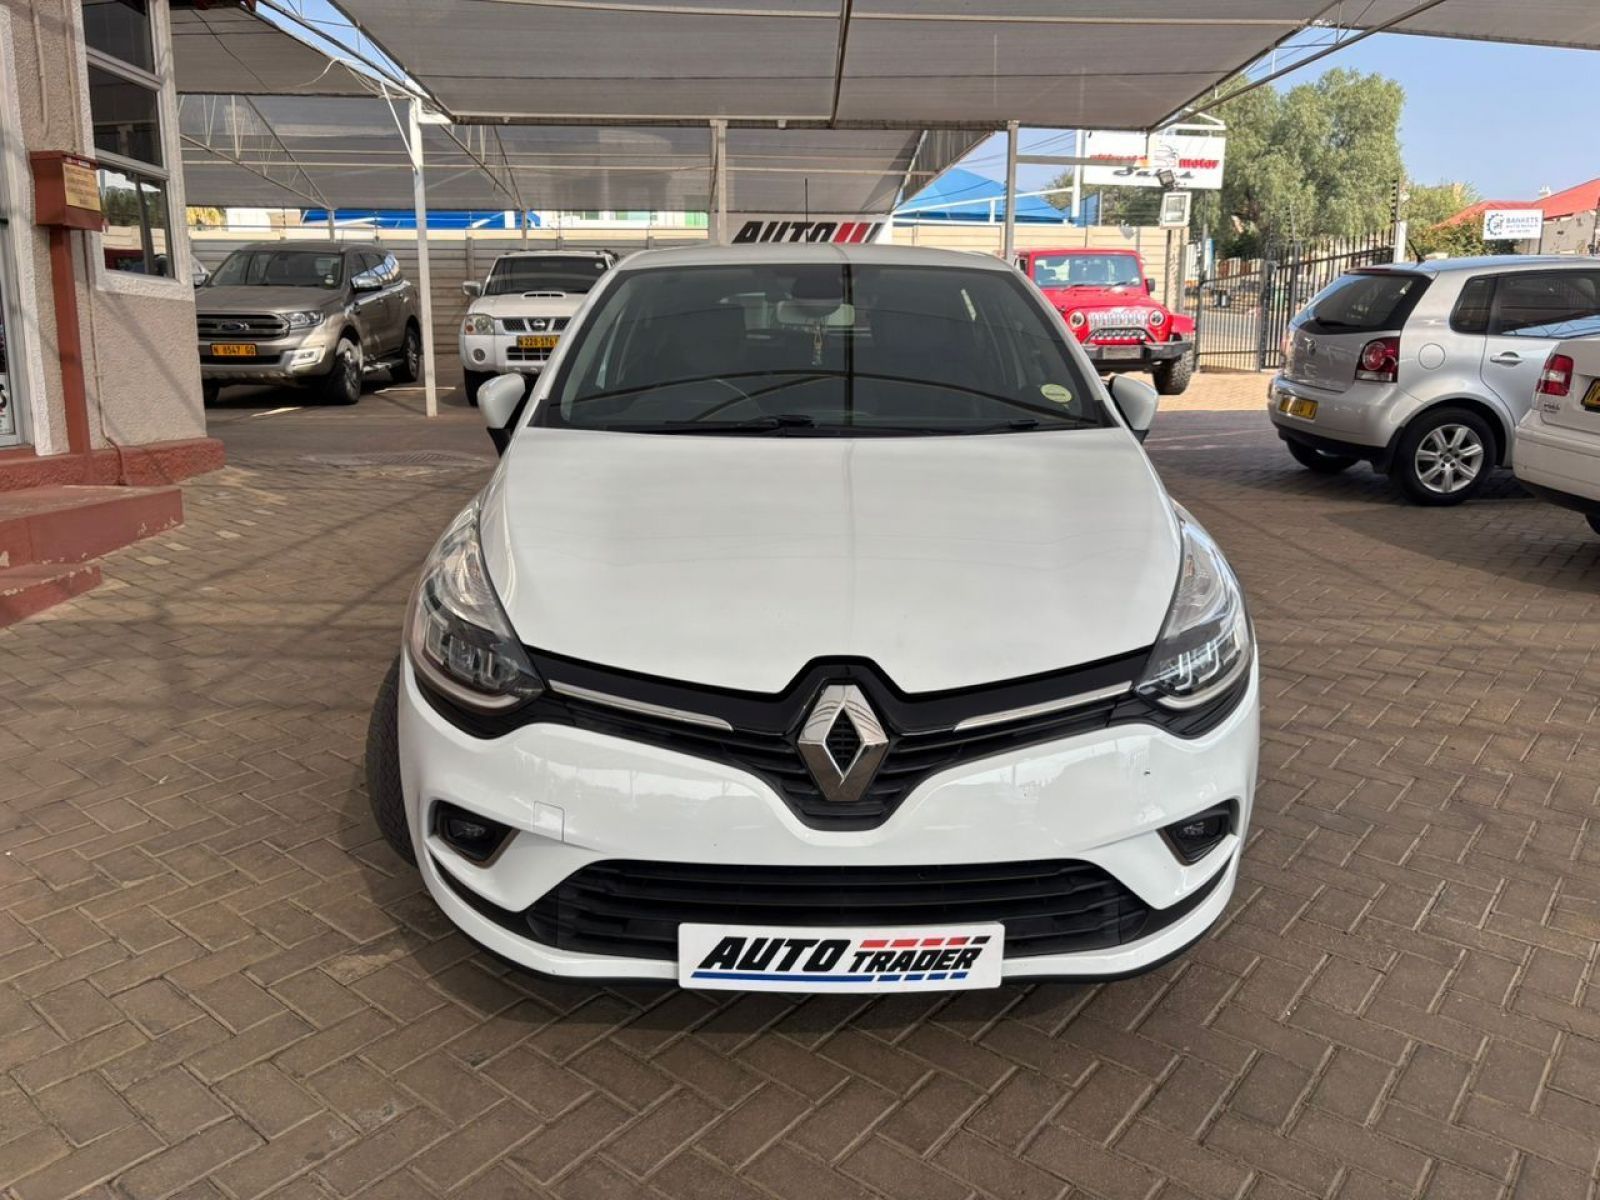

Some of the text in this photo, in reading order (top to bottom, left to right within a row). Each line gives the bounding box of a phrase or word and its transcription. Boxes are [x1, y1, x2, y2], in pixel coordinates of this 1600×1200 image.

[1179, 158, 1219, 169] motor
[696, 936, 982, 974] AUTO TRADER
